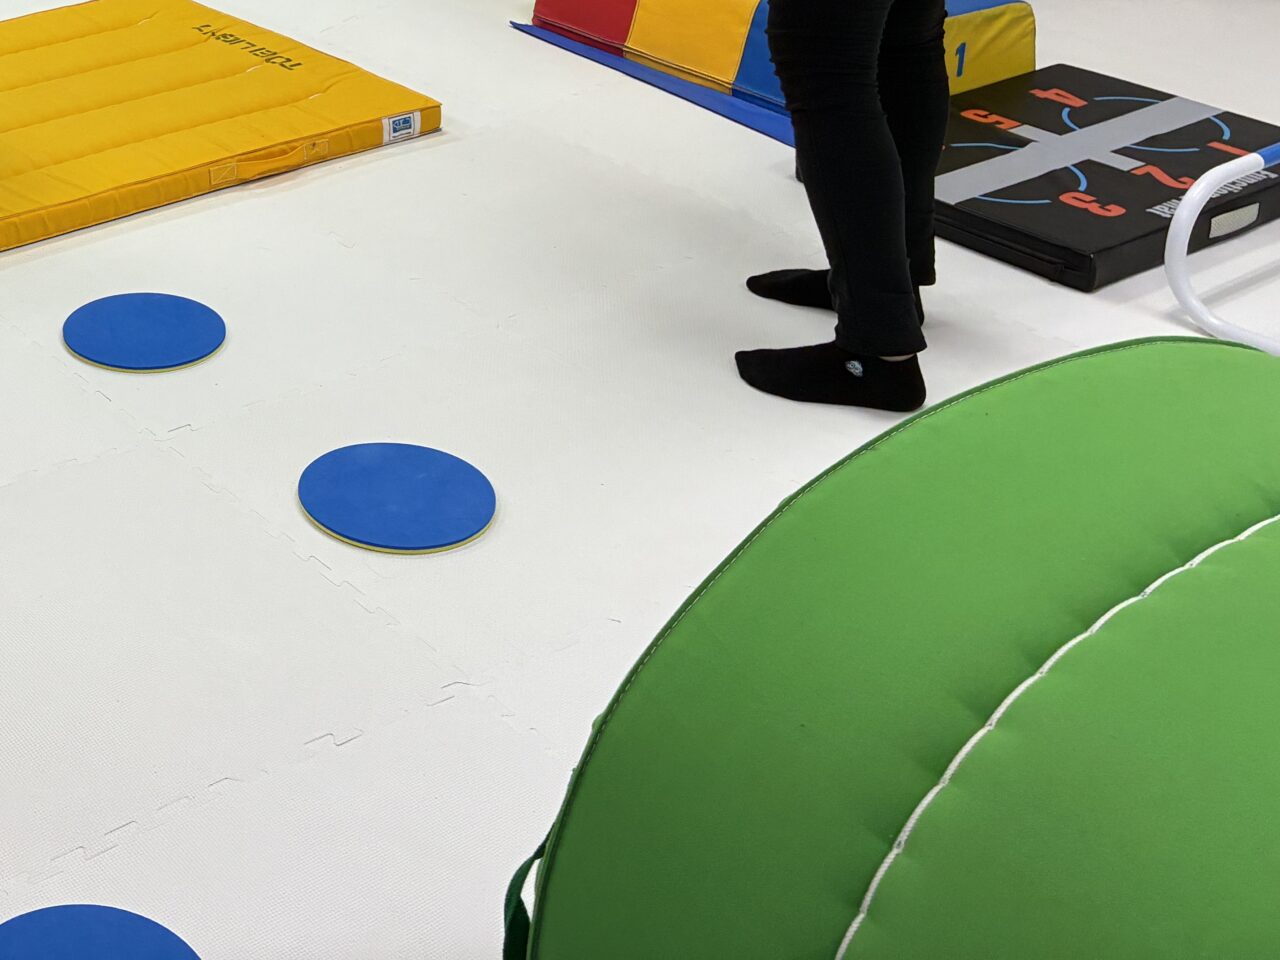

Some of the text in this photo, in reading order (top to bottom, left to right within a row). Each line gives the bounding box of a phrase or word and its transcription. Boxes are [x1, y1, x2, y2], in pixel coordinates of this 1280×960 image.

[955, 42, 966, 77] 1
[960, 88, 1088, 130] 4 5
[1131, 165, 1196, 190] 2
[1058, 192, 1126, 217] 3
